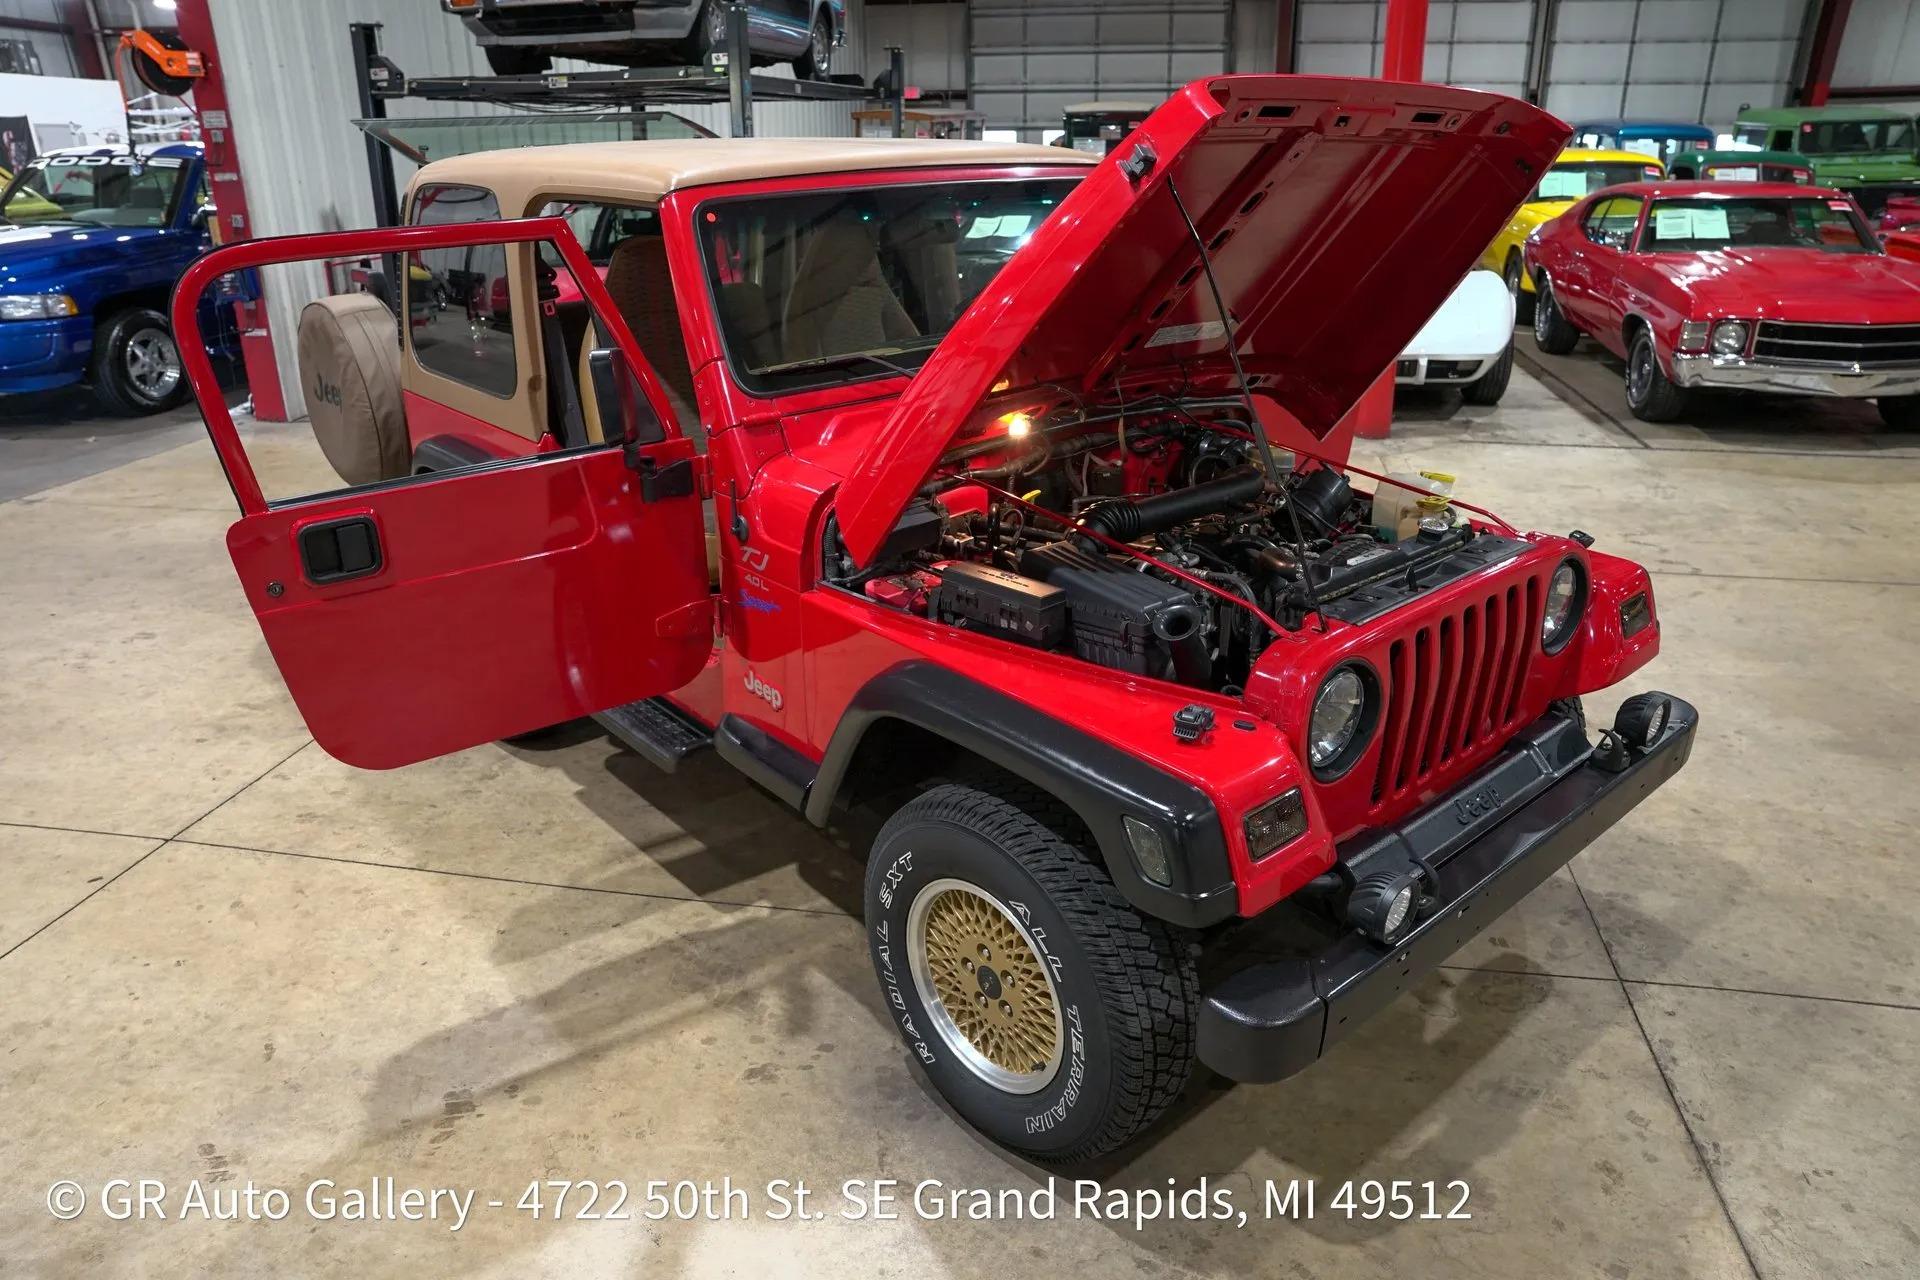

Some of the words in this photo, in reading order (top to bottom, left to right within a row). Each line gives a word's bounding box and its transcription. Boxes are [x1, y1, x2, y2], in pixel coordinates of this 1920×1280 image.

[27, 156, 184, 169] DODGE
[740, 546, 769, 571] TJ
[743, 669, 783, 710] Jeep
[1454, 784, 1502, 826] Jeep
[878, 851, 913, 910] SXT
[1008, 899, 1063, 983] ALL
[876, 920, 936, 1065] RADIAL
[1025, 1004, 1086, 1134] TERRAIN
